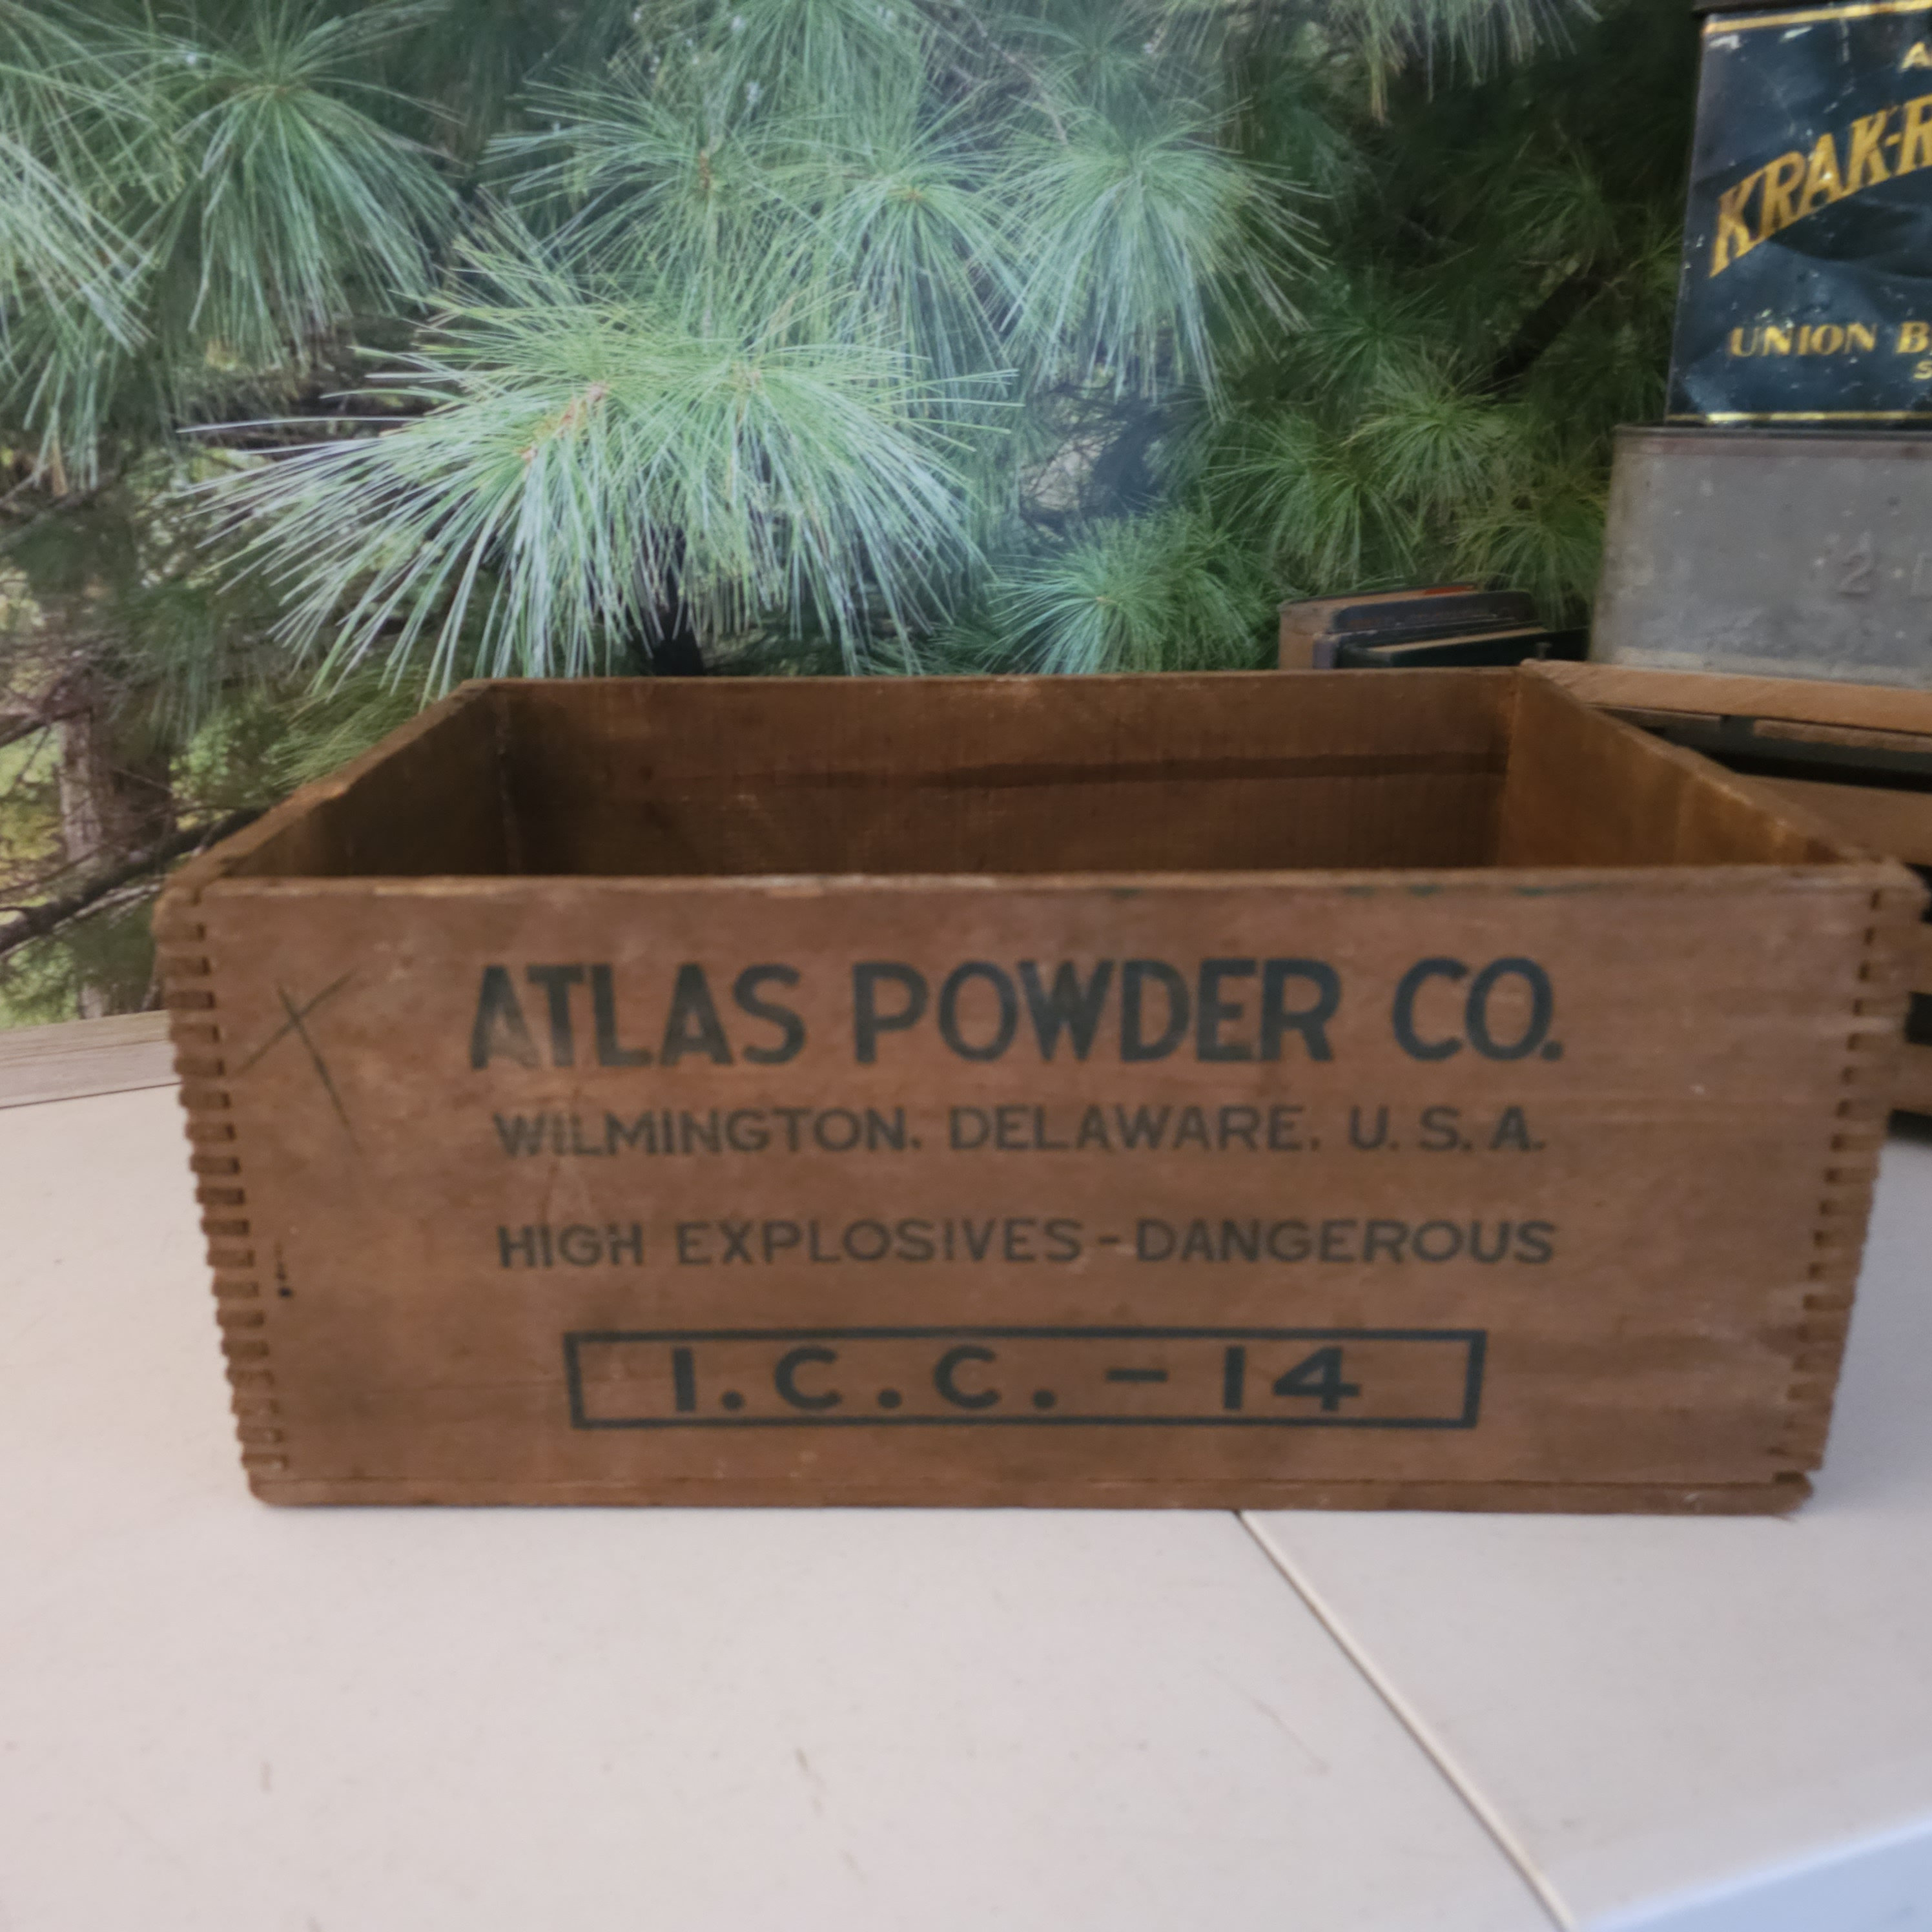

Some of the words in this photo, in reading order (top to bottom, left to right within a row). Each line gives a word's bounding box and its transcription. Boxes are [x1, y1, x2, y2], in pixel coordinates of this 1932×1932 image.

[1708, 94, 1932, 279] KRAK-R
[1729, 325, 1876, 358] UNION
[469, 963, 807, 1070] ATLAS
[851, 959, 1341, 1064] POWDER
[1392, 957, 1564, 1062] CO.
[497, 1222, 644, 1268] HIGH
